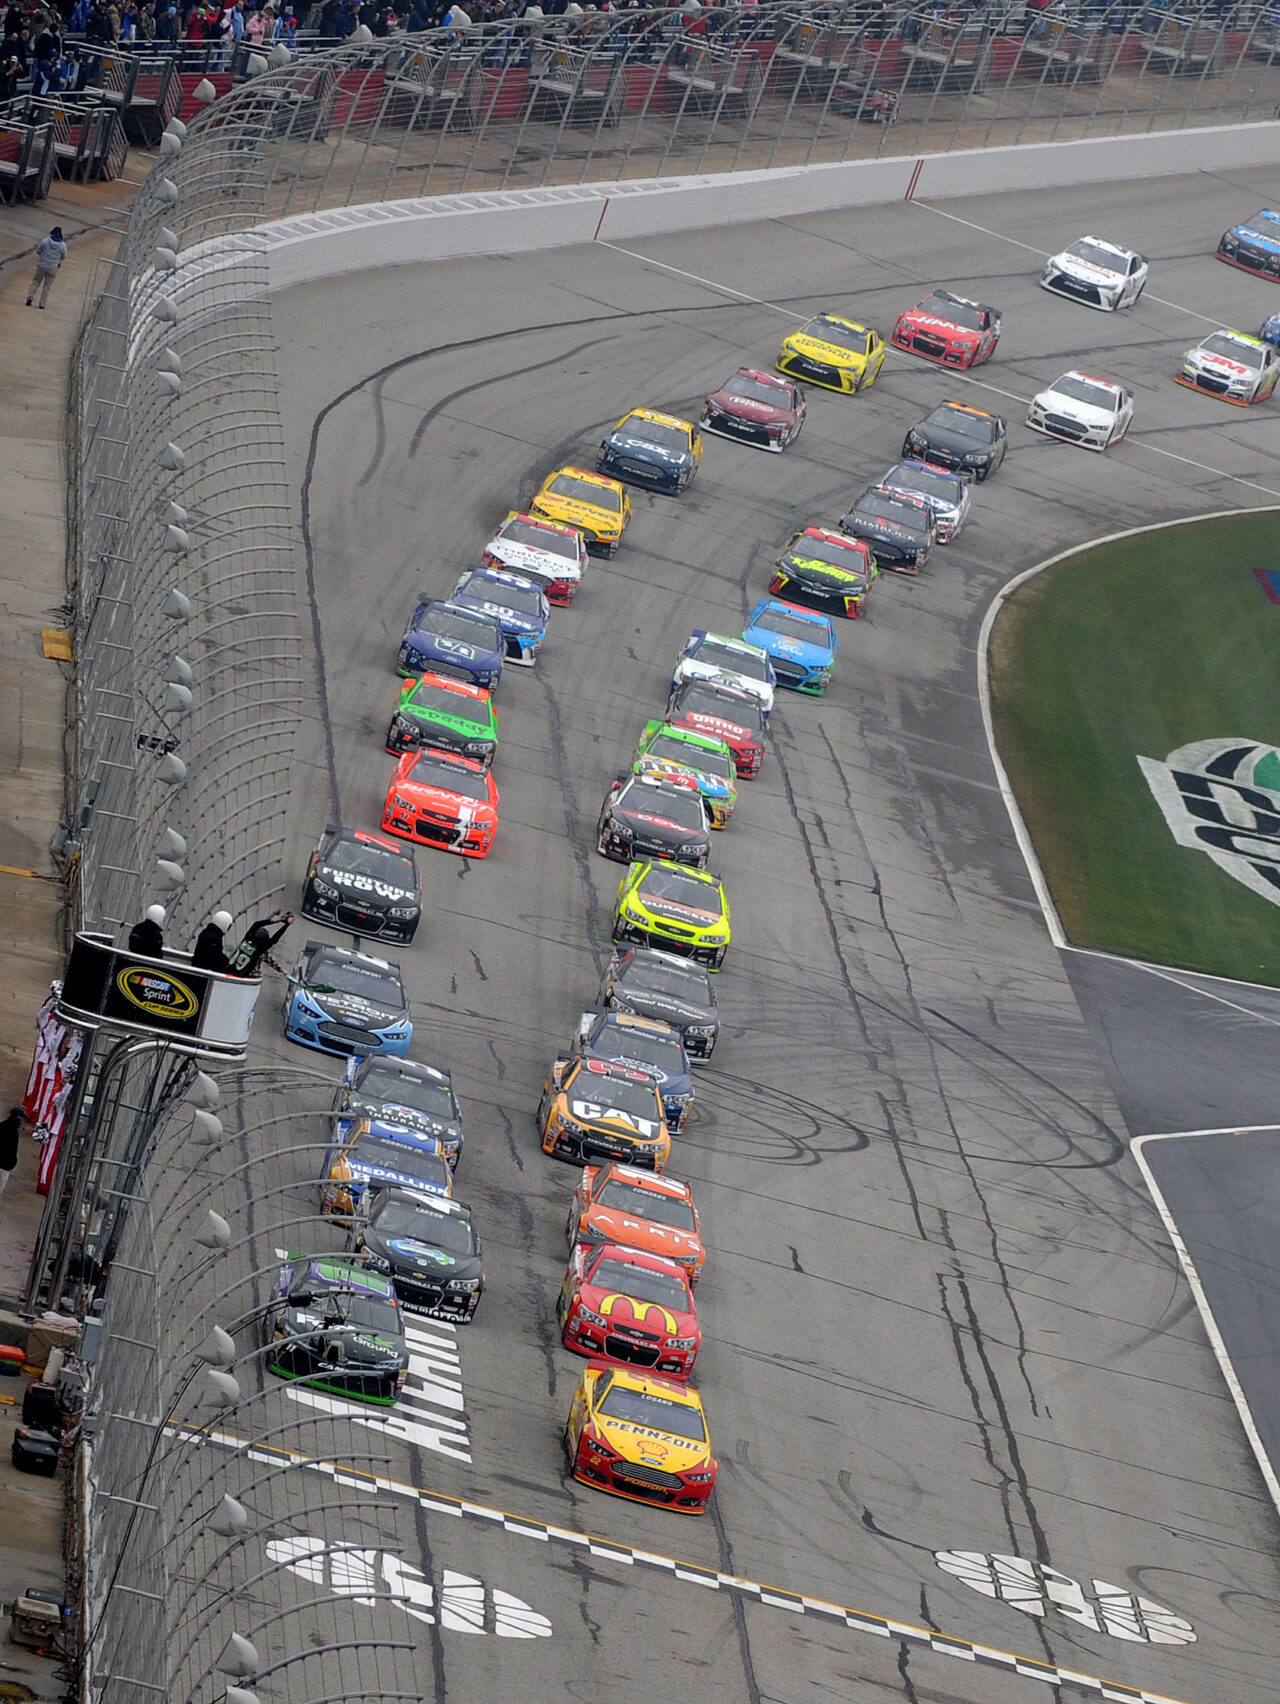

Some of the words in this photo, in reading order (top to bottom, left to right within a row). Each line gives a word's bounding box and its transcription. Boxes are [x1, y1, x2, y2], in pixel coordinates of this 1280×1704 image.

[1201, 353, 1247, 375] 3M
[637, 813, 690, 832] DOW
[322, 867, 416, 900] FURNITURE
[334, 876, 402, 900] ROW
[641, 899, 718, 925] DURACELL
[142, 977, 171, 991] NASCAR
[143, 987, 171, 1002] Sprint
[143, 1002, 160, 1011] CUP
[160, 1005, 185, 1016] SERIES
[311, 991, 401, 1021] DETROIT
[352, 1101, 458, 1136] FARMERS
[369, 1111, 440, 1135] INSURANCE
[573, 1100, 659, 1137] CAT
[346, 1159, 448, 1197] MEDALLION
[415, 1207, 444, 1219] LARSON
[623, 1263, 666, 1278] McMURRAY
[353, 1336, 399, 1359] Ground
[641, 1394, 673, 1406] LOGANO
[606, 1420, 702, 1452] PENNZOIL
[623, 1477, 668, 1493] FUSION
